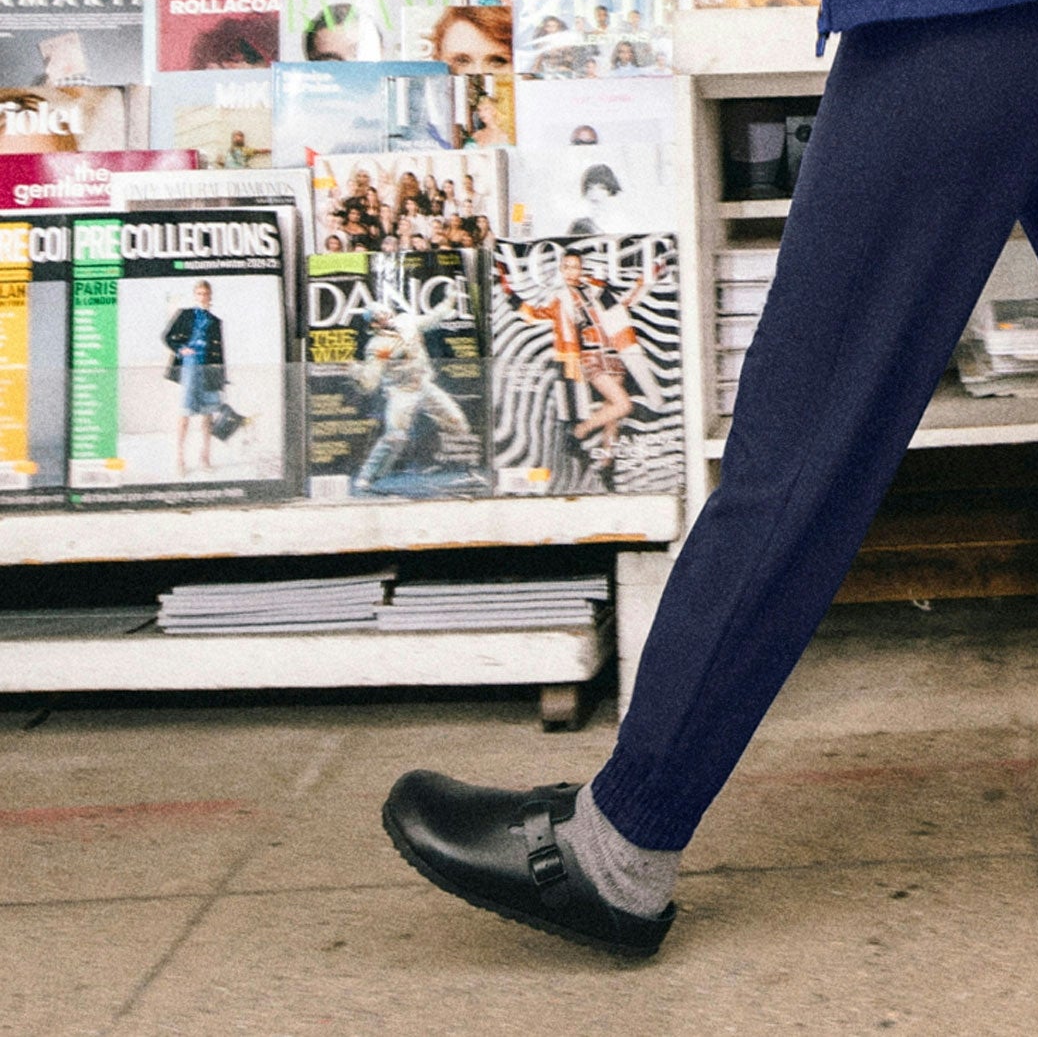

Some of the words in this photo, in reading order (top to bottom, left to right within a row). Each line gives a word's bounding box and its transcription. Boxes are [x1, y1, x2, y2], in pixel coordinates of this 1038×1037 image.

[75, 160, 109, 182] the
[73, 224, 121, 261] PRE
[120, 221, 282, 260] COLLECTIONS
[74, 281, 118, 297] PARIS
[309, 328, 358, 347] THE
